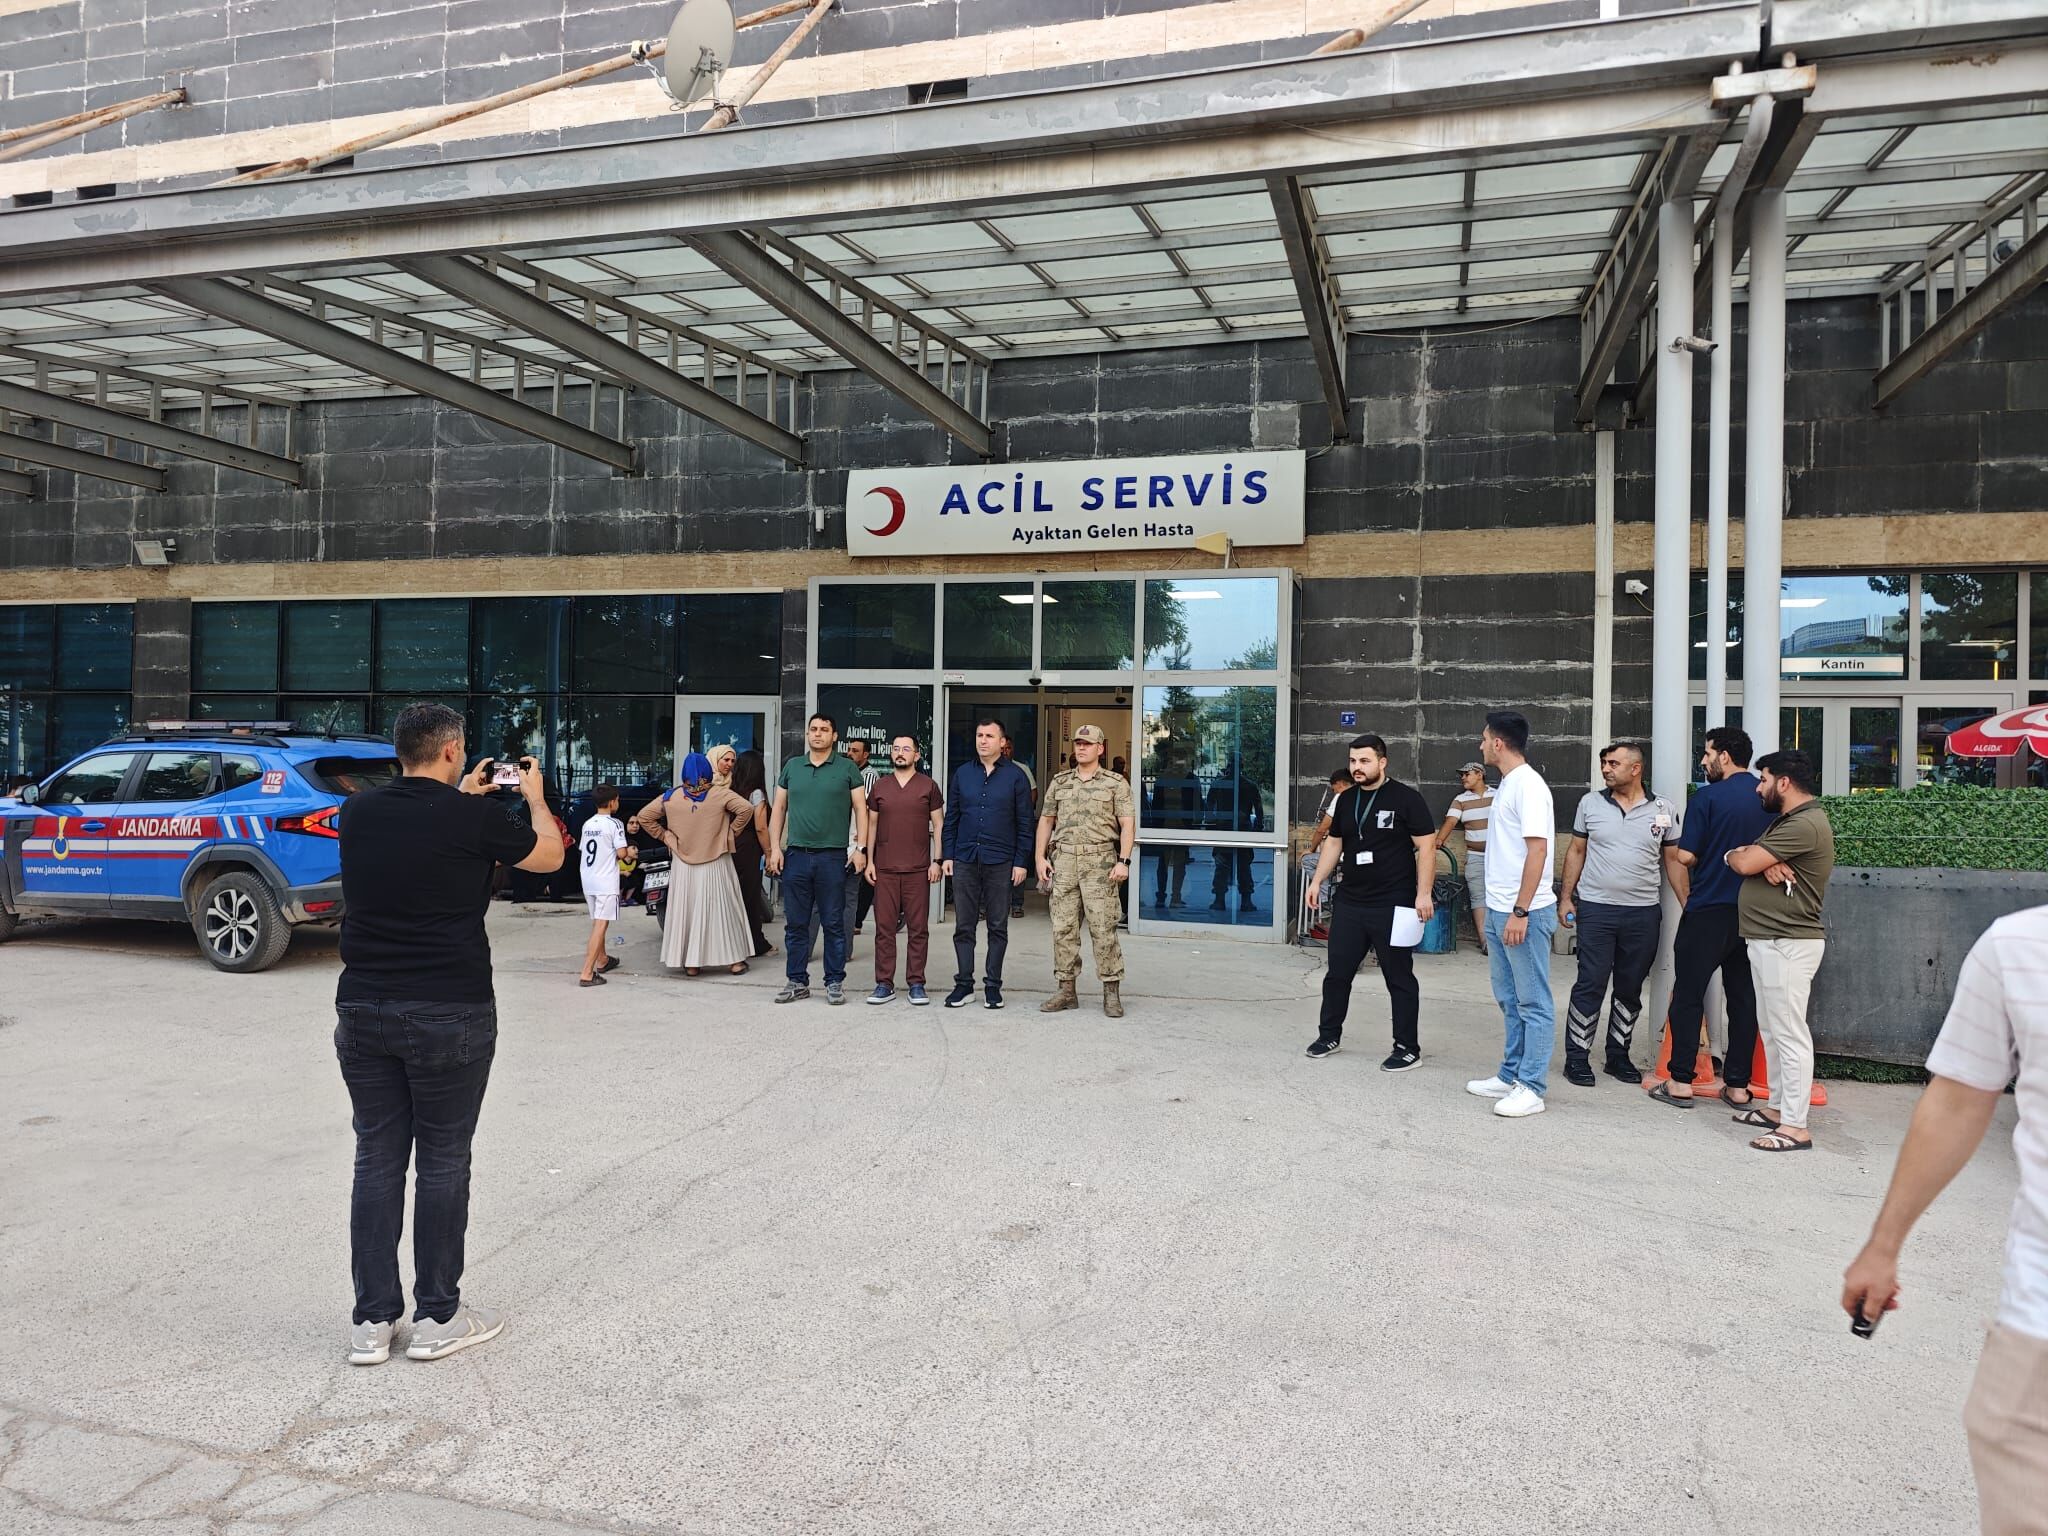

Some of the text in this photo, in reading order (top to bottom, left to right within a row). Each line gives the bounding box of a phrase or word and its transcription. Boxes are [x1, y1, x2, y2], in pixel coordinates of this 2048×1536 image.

[940, 463, 1268, 515] ACİL SERVİS
[1012, 523, 1195, 545] Ayaktan Gelen Hasta
[1821, 658, 1864, 670] Kantin
[266, 772, 283, 785] 112
[118, 818, 202, 837] JANDARMA
[586, 839, 598, 867] 9
[26, 864, 103, 877] www.jandarma.gov.tr
